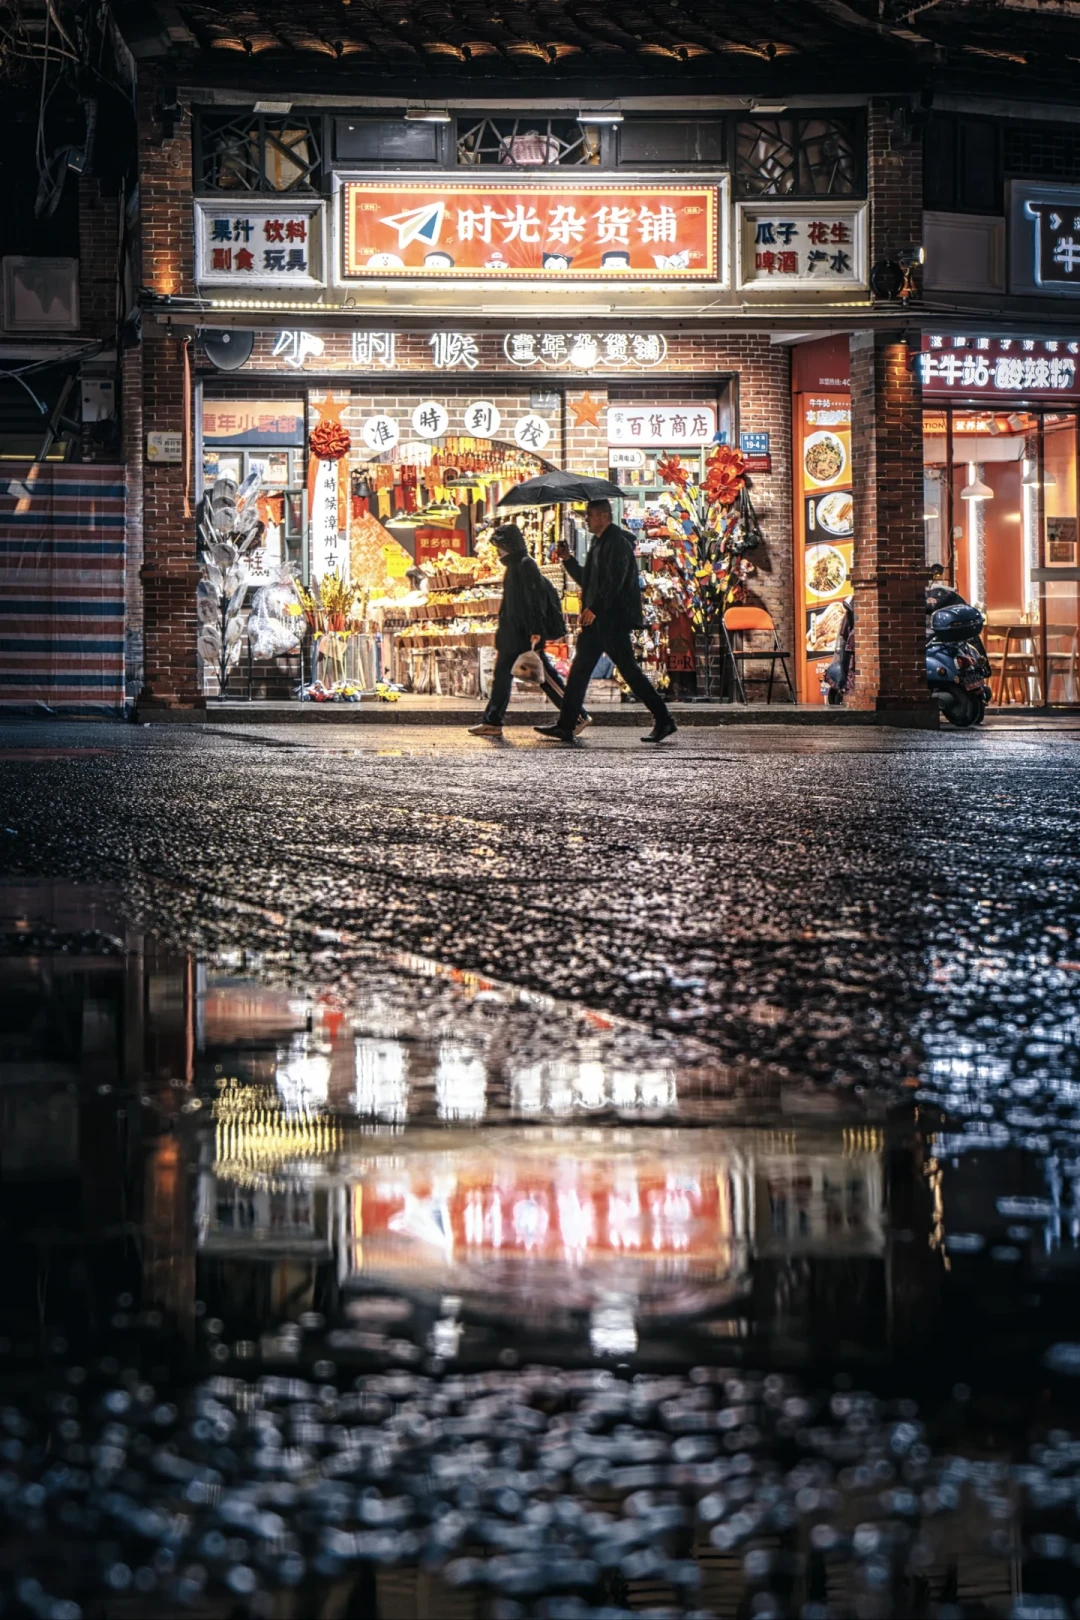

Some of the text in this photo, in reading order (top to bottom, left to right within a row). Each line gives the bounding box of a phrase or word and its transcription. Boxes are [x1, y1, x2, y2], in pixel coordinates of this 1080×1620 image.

[211, 218, 307, 243] 果汁 饮料
[456, 204, 678, 244] 时光杂货铺
[754, 221, 851, 246] 瓜子 花生
[211, 247, 307, 272] 副食 玩具
[755, 249, 851, 274] 啤酒 汽水
[203, 413, 298, 434] 童年小卖部
[626, 414, 708, 438] 百货商店
[420, 538, 461, 548] 更多惊喜
